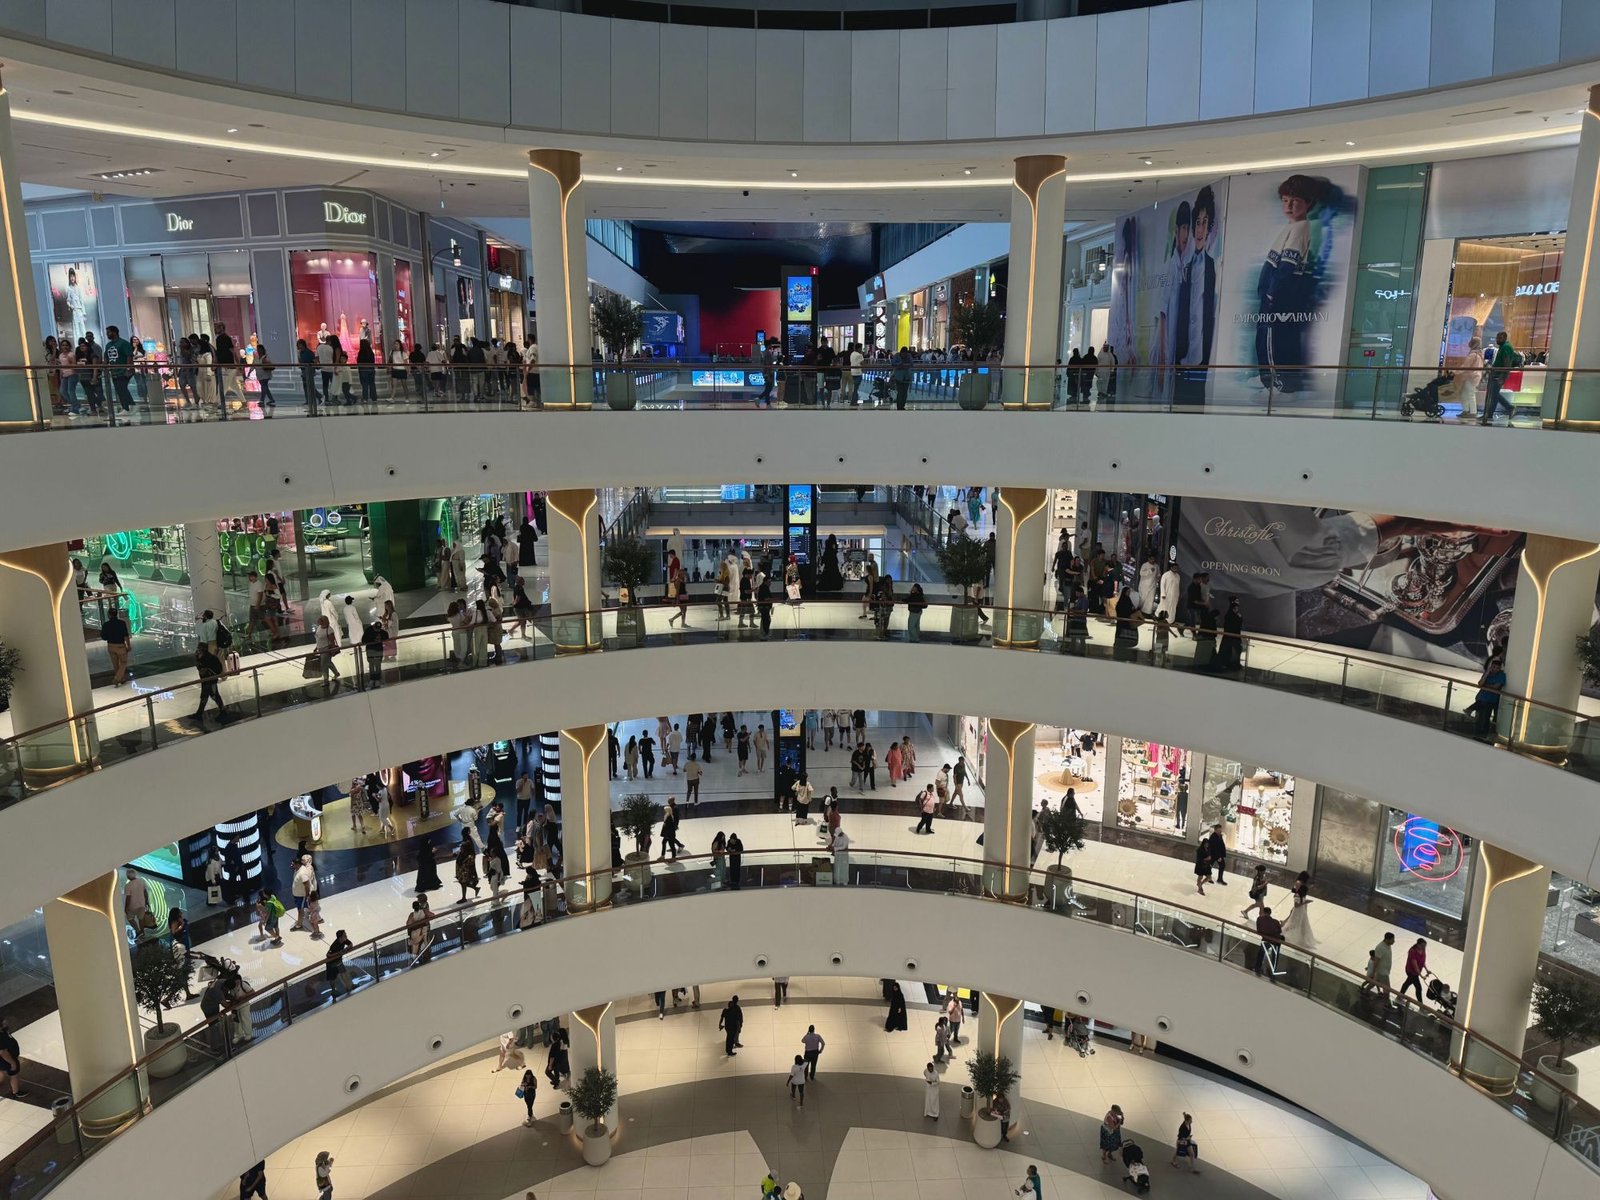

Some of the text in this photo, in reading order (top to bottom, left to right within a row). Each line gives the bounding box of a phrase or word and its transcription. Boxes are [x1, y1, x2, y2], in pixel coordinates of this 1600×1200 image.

[165, 212, 194, 231] Dior
[323, 201, 367, 224] Dior
[1232, 311, 1329, 323] EMPORIO ARMANI
[1204, 516, 1286, 545] Christofle
[1201, 560, 1281, 577] OPENING SOON
